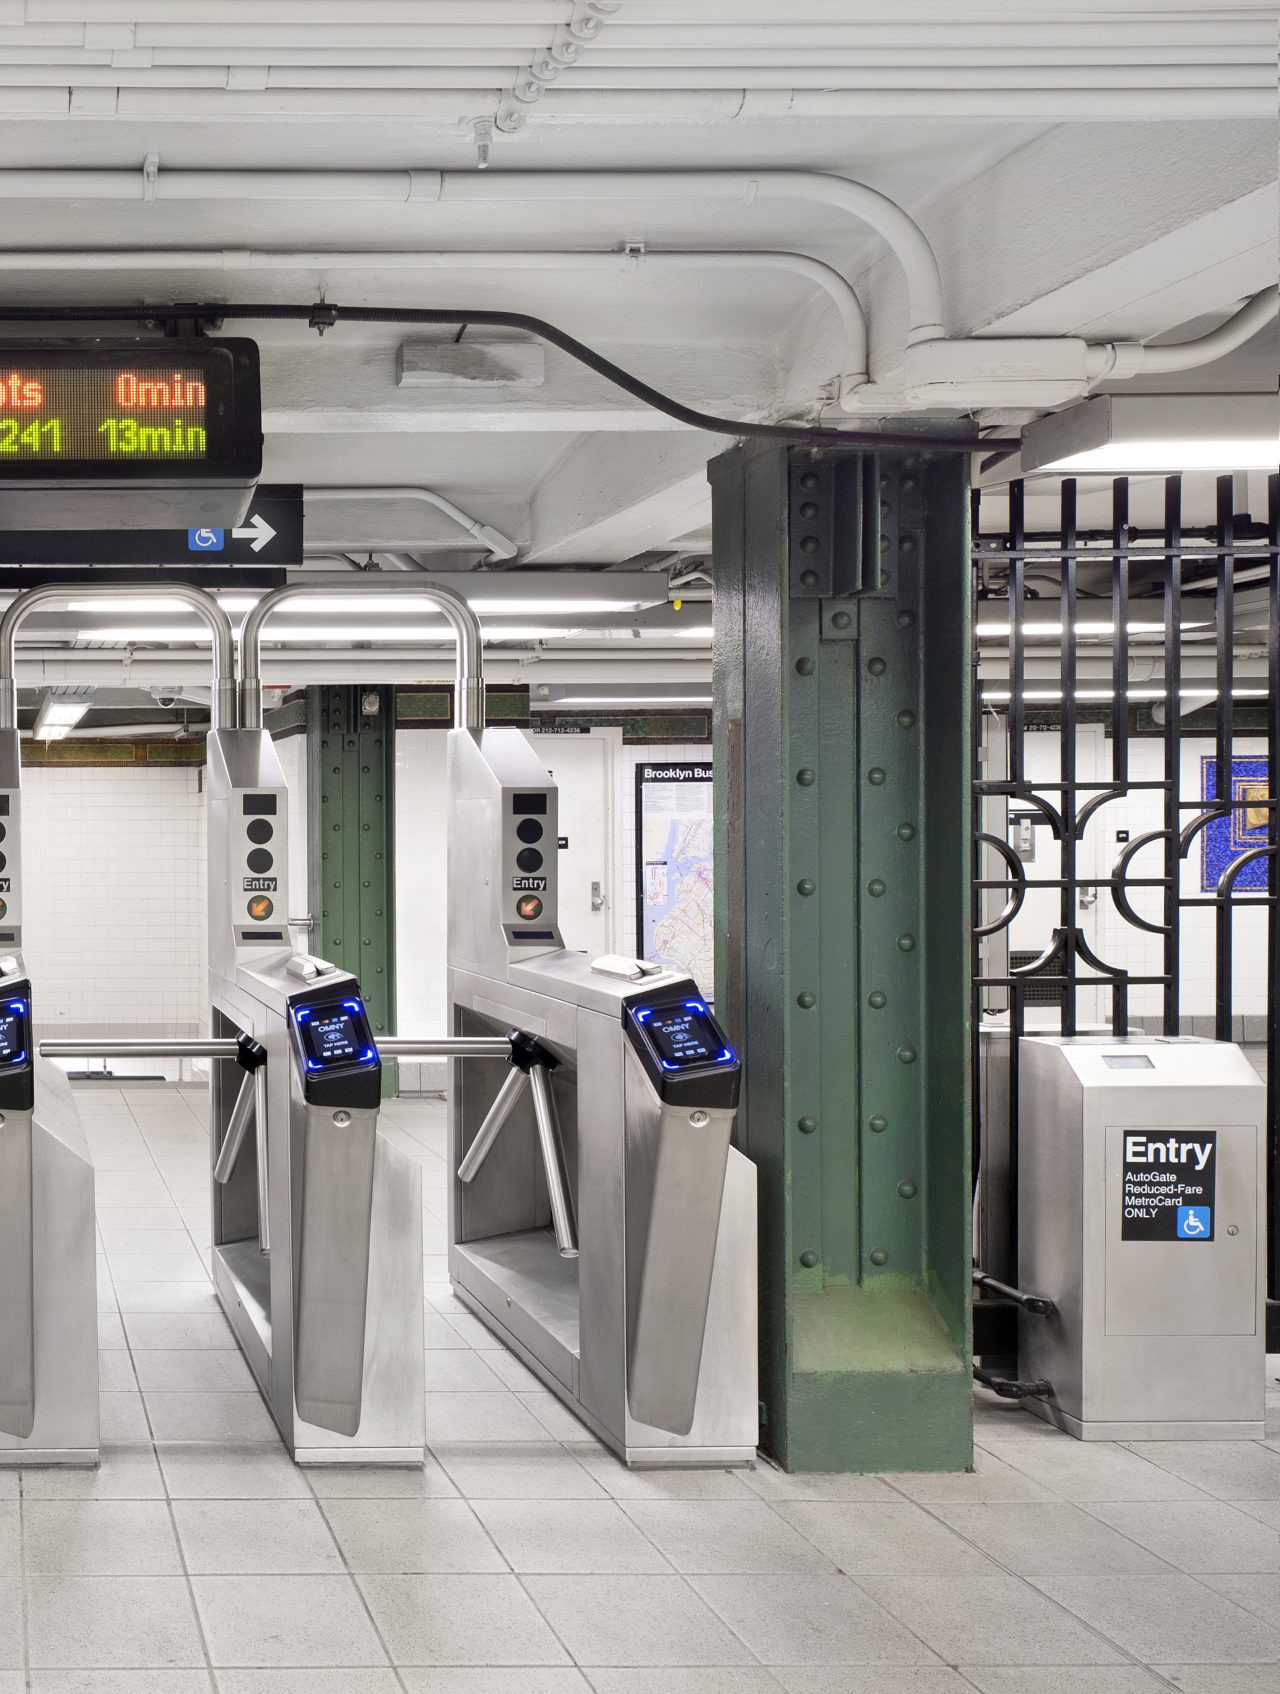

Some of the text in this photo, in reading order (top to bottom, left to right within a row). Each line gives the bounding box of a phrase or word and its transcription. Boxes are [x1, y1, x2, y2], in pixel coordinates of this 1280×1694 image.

[117, 373, 207, 408] 0min
[97, 418, 207, 453] 13min
[644, 768, 693, 780] Brooklyn
[244, 878, 276, 891] Entry
[513, 877, 546, 891] Entry
[317, 1022, 345, 1033] OMNY
[662, 1022, 690, 1033] OMNY
[1125, 1136, 1213, 1171] Entry
[1124, 1171, 1177, 1182] AutoGate
[1124, 1183, 1203, 1194] Reduced-Fare
[1124, 1195, 1183, 1206] MetroCard
[1124, 1207, 1158, 1218] ONLY
